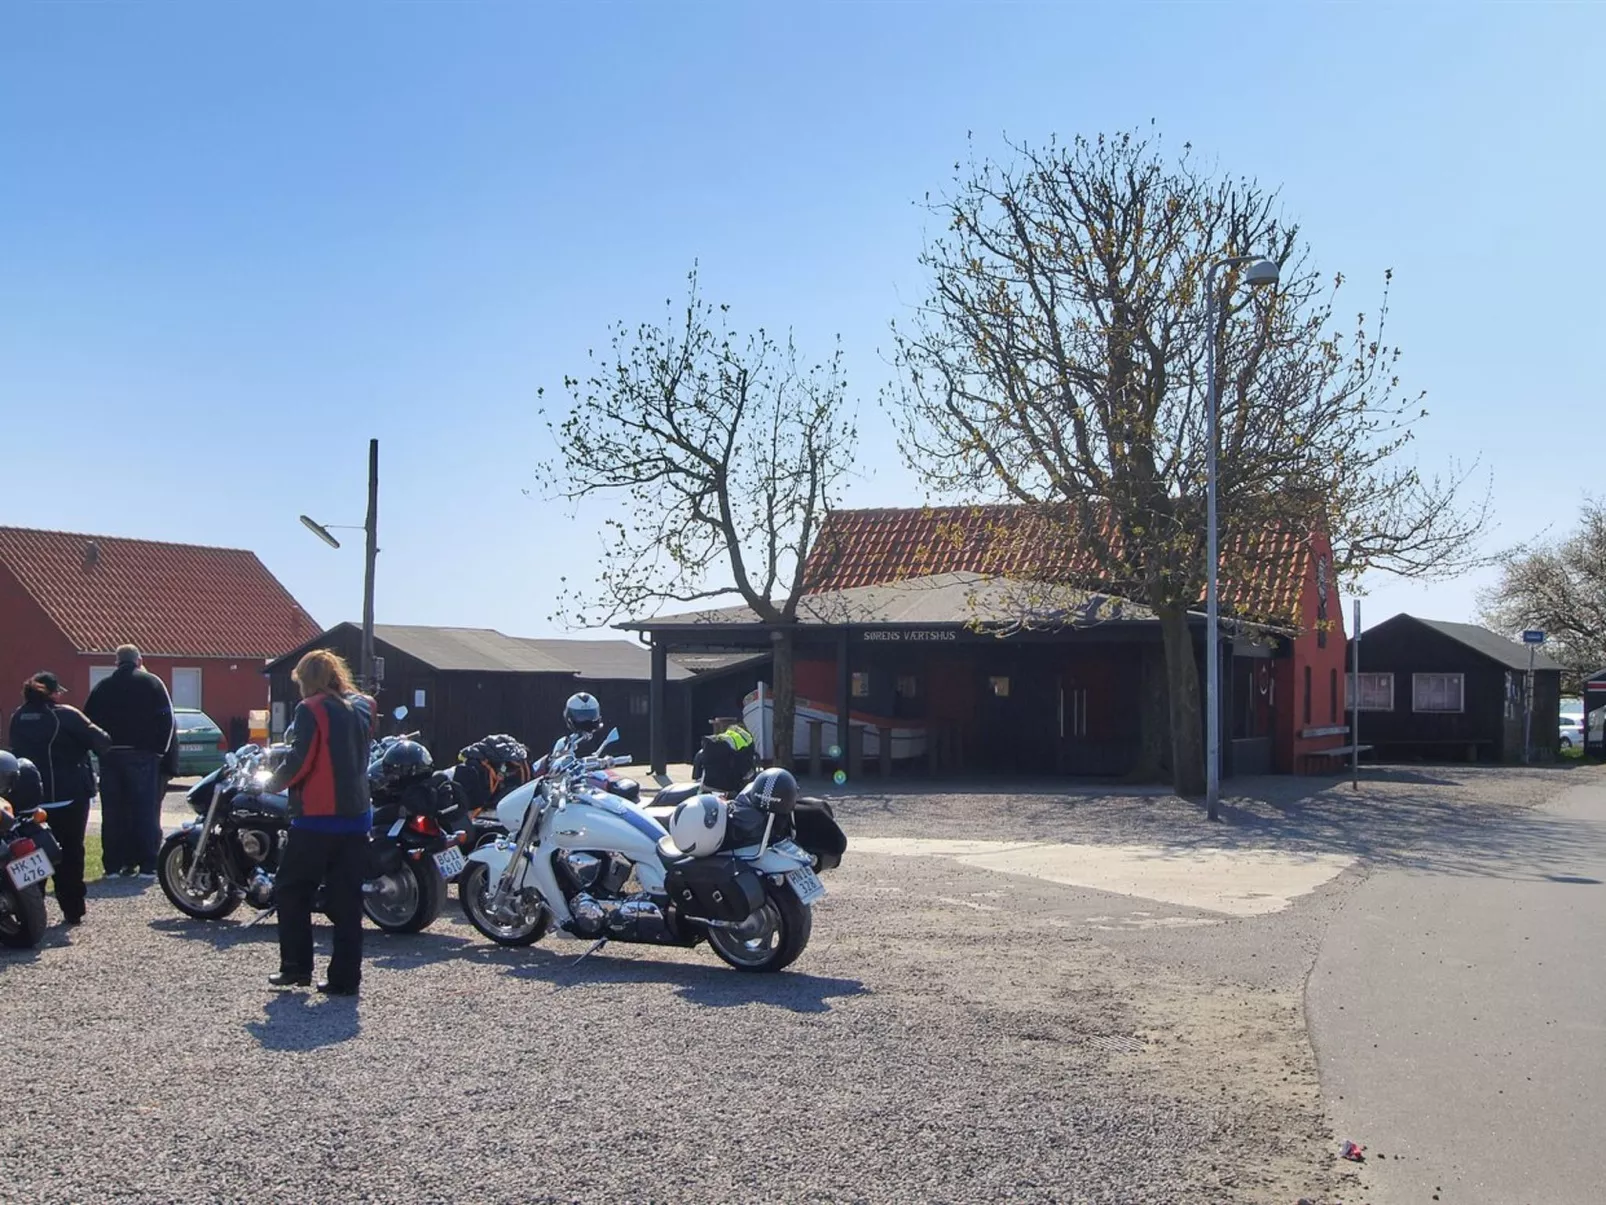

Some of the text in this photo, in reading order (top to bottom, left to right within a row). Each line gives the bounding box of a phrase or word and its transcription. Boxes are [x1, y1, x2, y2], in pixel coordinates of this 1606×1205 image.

[863, 631, 956, 641] SØRENS VÆRTSHUS
[11, 860, 29, 875] HK
[24, 866, 45, 882] 476
[446, 860, 462, 875] 610
